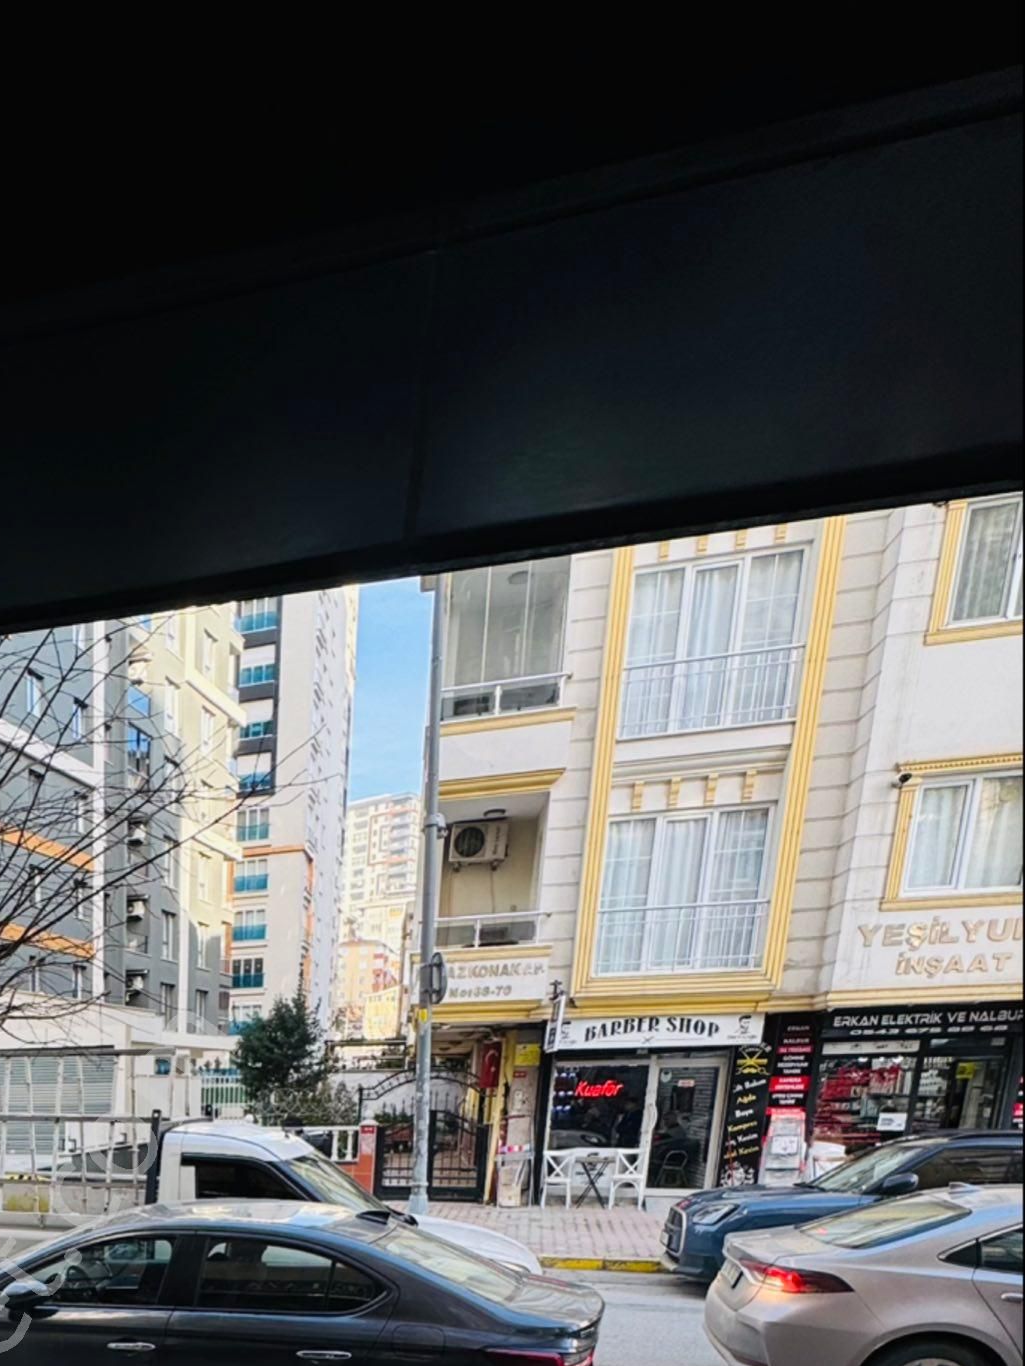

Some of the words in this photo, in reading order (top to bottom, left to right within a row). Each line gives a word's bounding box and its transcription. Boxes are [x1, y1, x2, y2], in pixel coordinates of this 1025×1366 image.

[895, 952, 1012, 978] İNŞAAT
[584, 1015, 660, 1042] BARBER
[666, 1016, 720, 1039] SHOP
[833, 1015, 878, 1027] ERKAN
[881, 1011, 943, 1026] ELEKTRİK
[947, 1012, 967, 1023] VE
[575, 1079, 624, 1098] Kuaför
